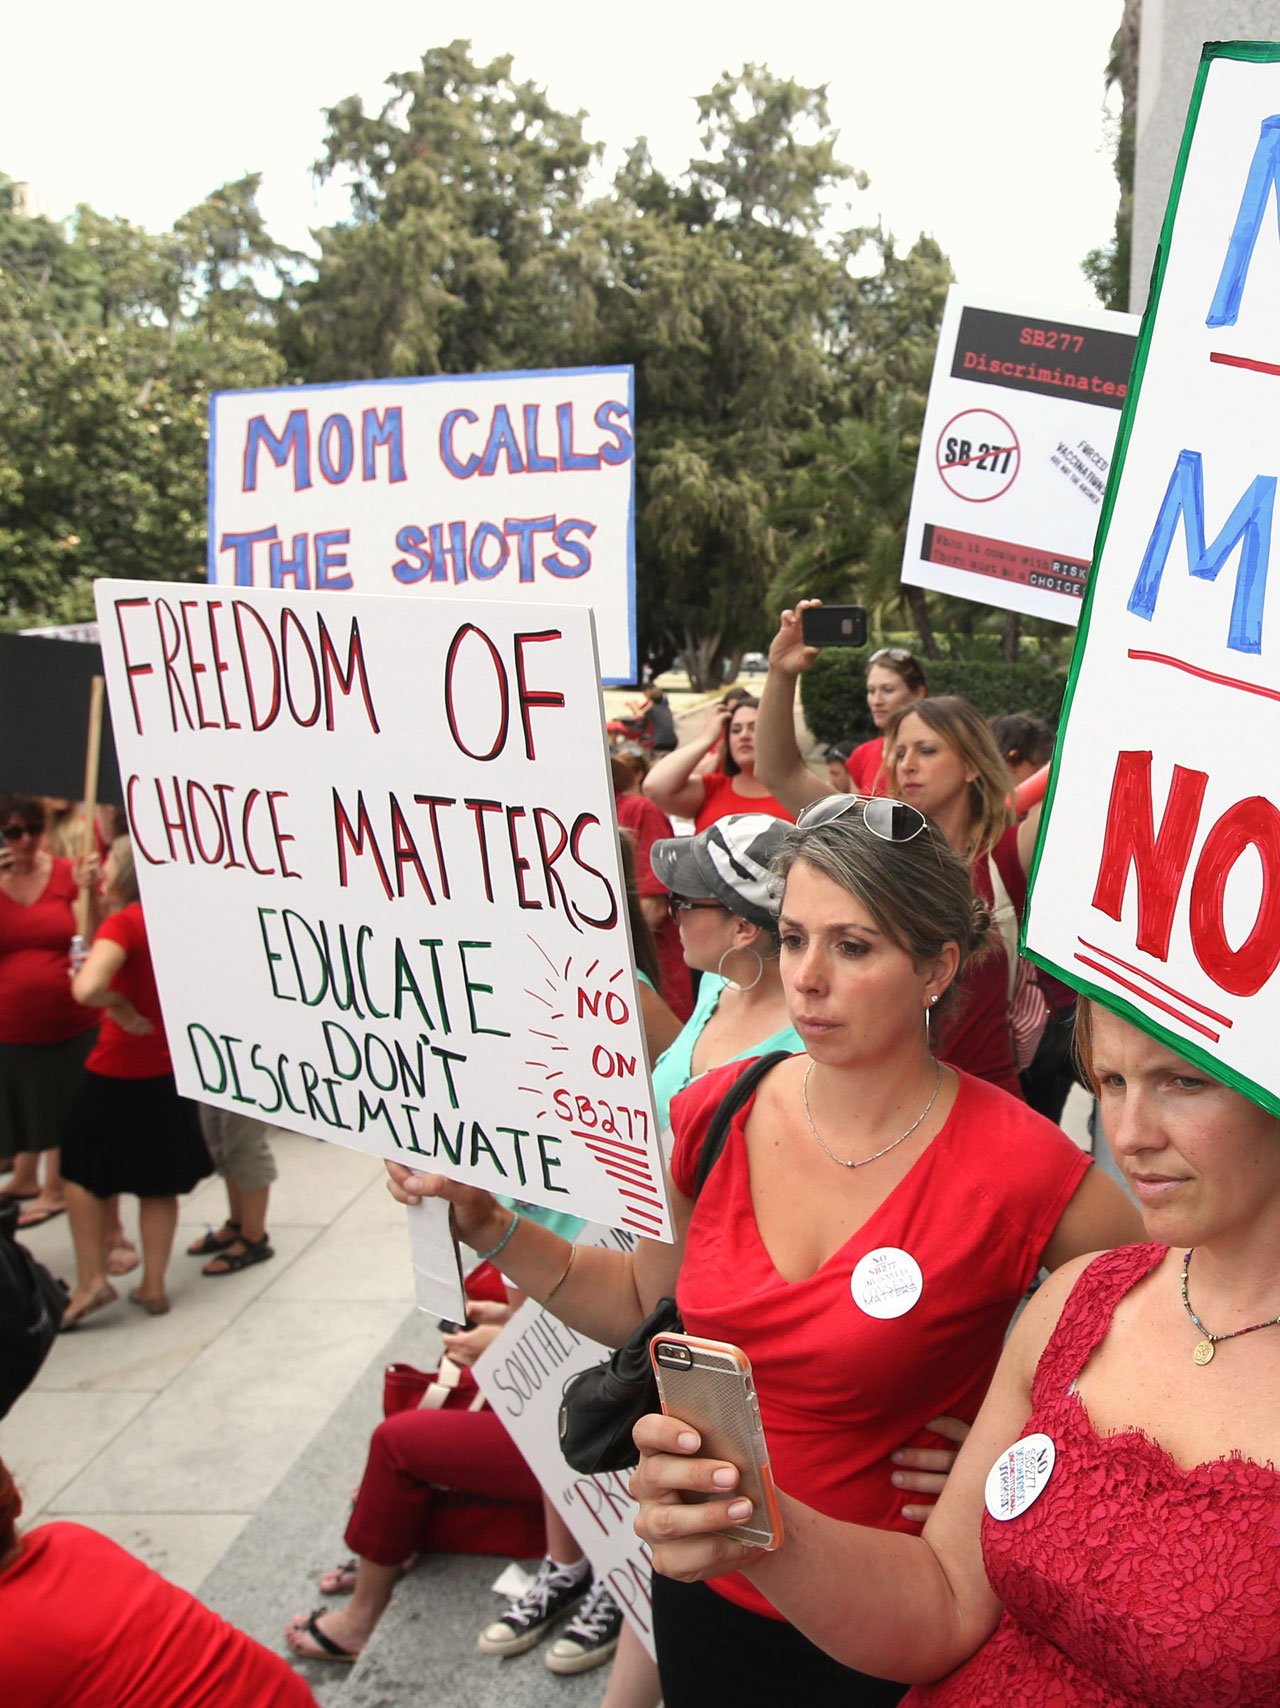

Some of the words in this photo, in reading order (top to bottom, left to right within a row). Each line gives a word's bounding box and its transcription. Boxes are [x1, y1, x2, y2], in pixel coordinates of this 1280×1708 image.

[1019, 327, 1085, 353] SB277
[963, 351, 1127, 398] Discriminates
[241, 406, 408, 492] MOM
[439, 400, 634, 479] CALLS
[1077, 440, 1109, 472] FORCED
[220, 525, 354, 590] THE
[392, 512, 597, 585] SHOTS
[1052, 562, 1087, 579] RISK
[1029, 573, 1081, 595] CHOICE
[114, 597, 381, 735] FREEDOM
[444, 622, 565, 761] OF
[126, 774, 302, 879] CHOICE
[331, 786, 619, 934] MATTERS
[257, 906, 511, 1038] EDUCATE
[576, 986, 630, 1025] NO
[322, 1020, 467, 1109] DON'T
[592, 1045, 637, 1078] ON
[186, 1023, 570, 1195] DISCRIMINATE
[551, 1088, 649, 1144] SB277
[1037, 1448, 1048, 1474] NO
